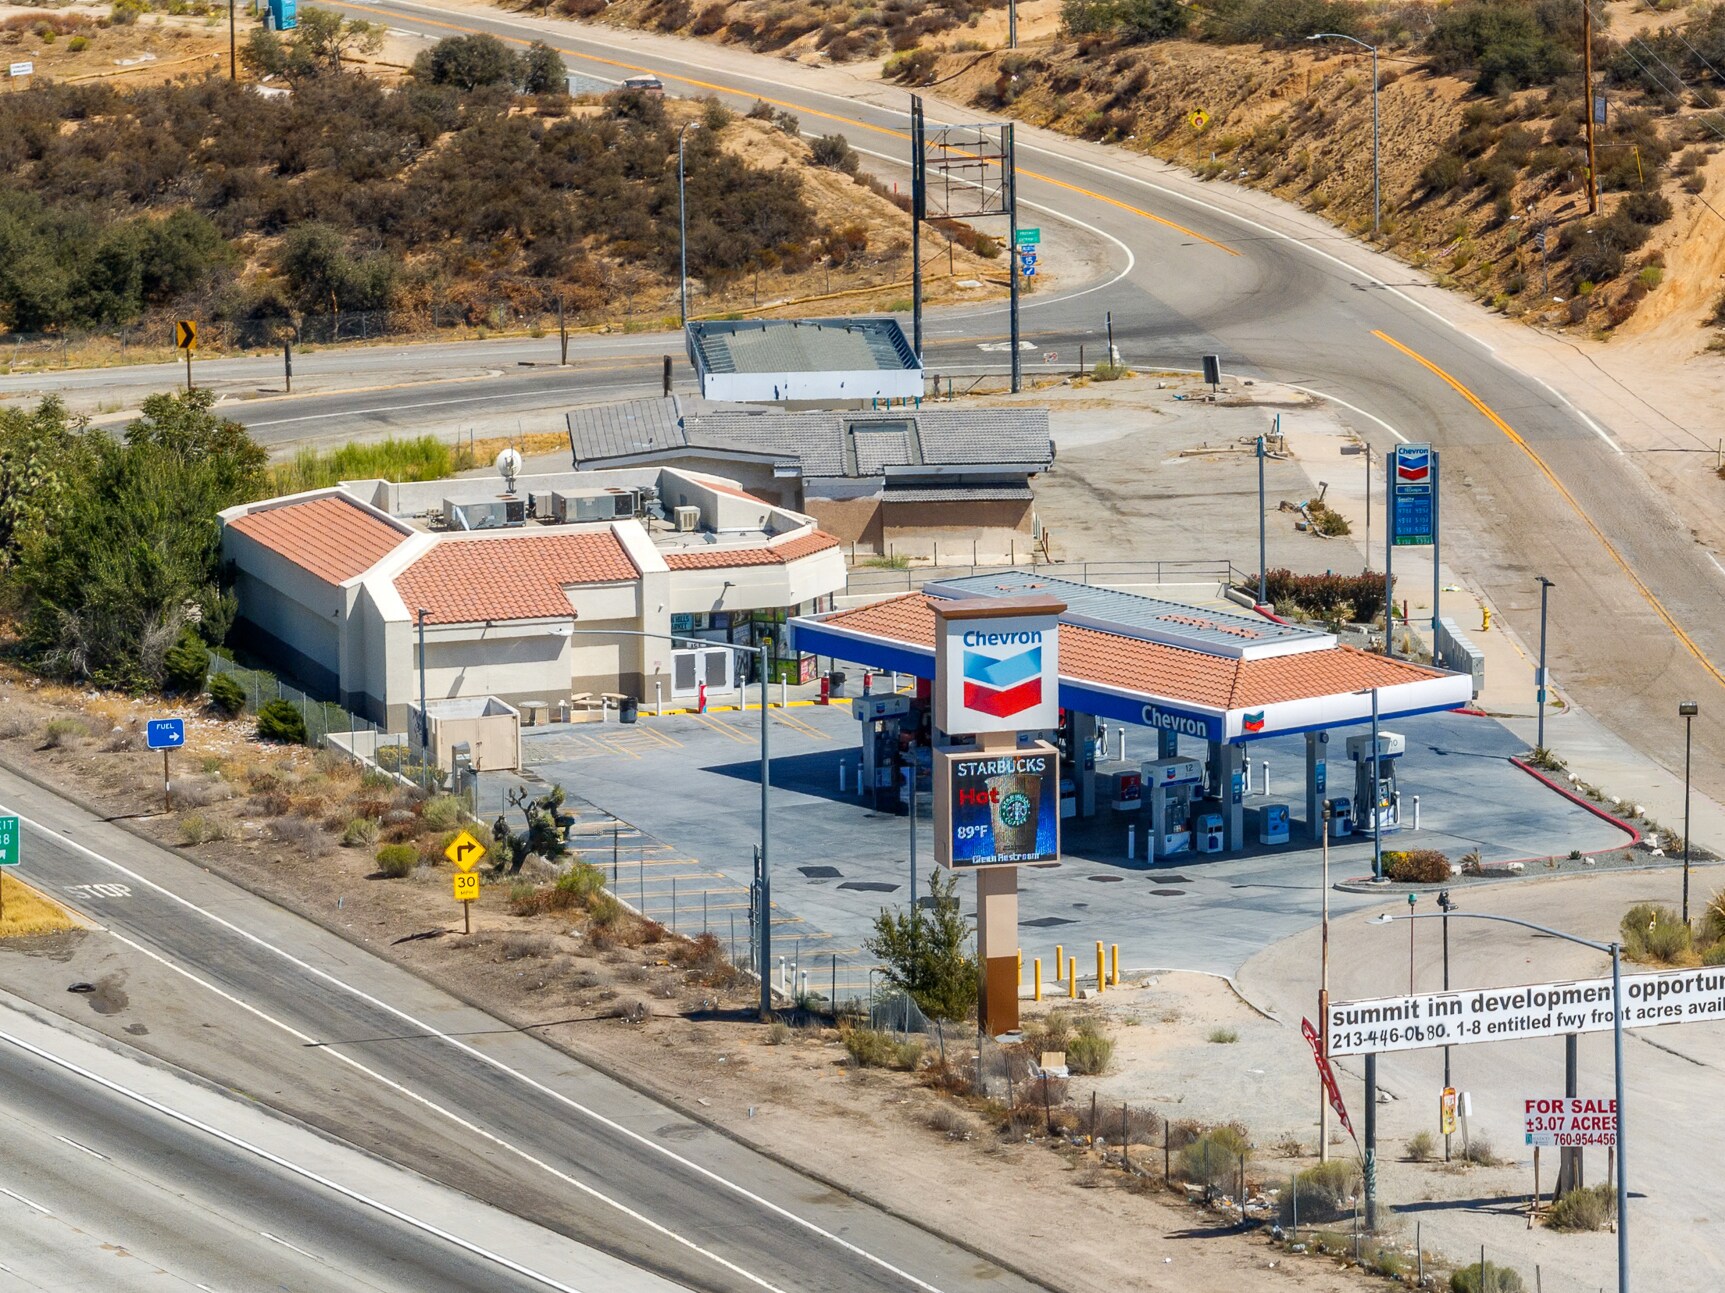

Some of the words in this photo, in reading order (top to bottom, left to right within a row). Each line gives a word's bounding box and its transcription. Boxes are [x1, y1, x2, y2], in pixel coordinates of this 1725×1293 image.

[1398, 447, 1429, 455] Chevron
[963, 630, 1042, 647] Chevron
[1141, 704, 1207, 737] Chevron
[957, 757, 1046, 777] STARBUCKS
[1185, 764, 1194, 772] 12
[959, 787, 1000, 806] Hot
[0, 819, 14, 830] IT
[957, 825, 988, 839] 89°F
[972, 854, 997, 864] Clean
[997, 852, 1040, 862] Restroom
[458, 876, 476, 888] 30
[63, 882, 132, 899] STOP
[1332, 999, 1420, 1027] summit
[1428, 997, 1463, 1018] inn
[1471, 986, 1615, 1013] developmen
[1456, 1020, 1481, 1037] 1-8
[1487, 1013, 1551, 1034] entitled
[1556, 1011, 1586, 1029] fwy
[1591, 1006, 1631, 1024] frot
[1636, 1004, 1683, 1019] acres
[1525, 1099, 1564, 1114] FOR
[1526, 1116, 1565, 1132] ±3.07
[1553, 1133, 1617, 1146] 760-954-456
